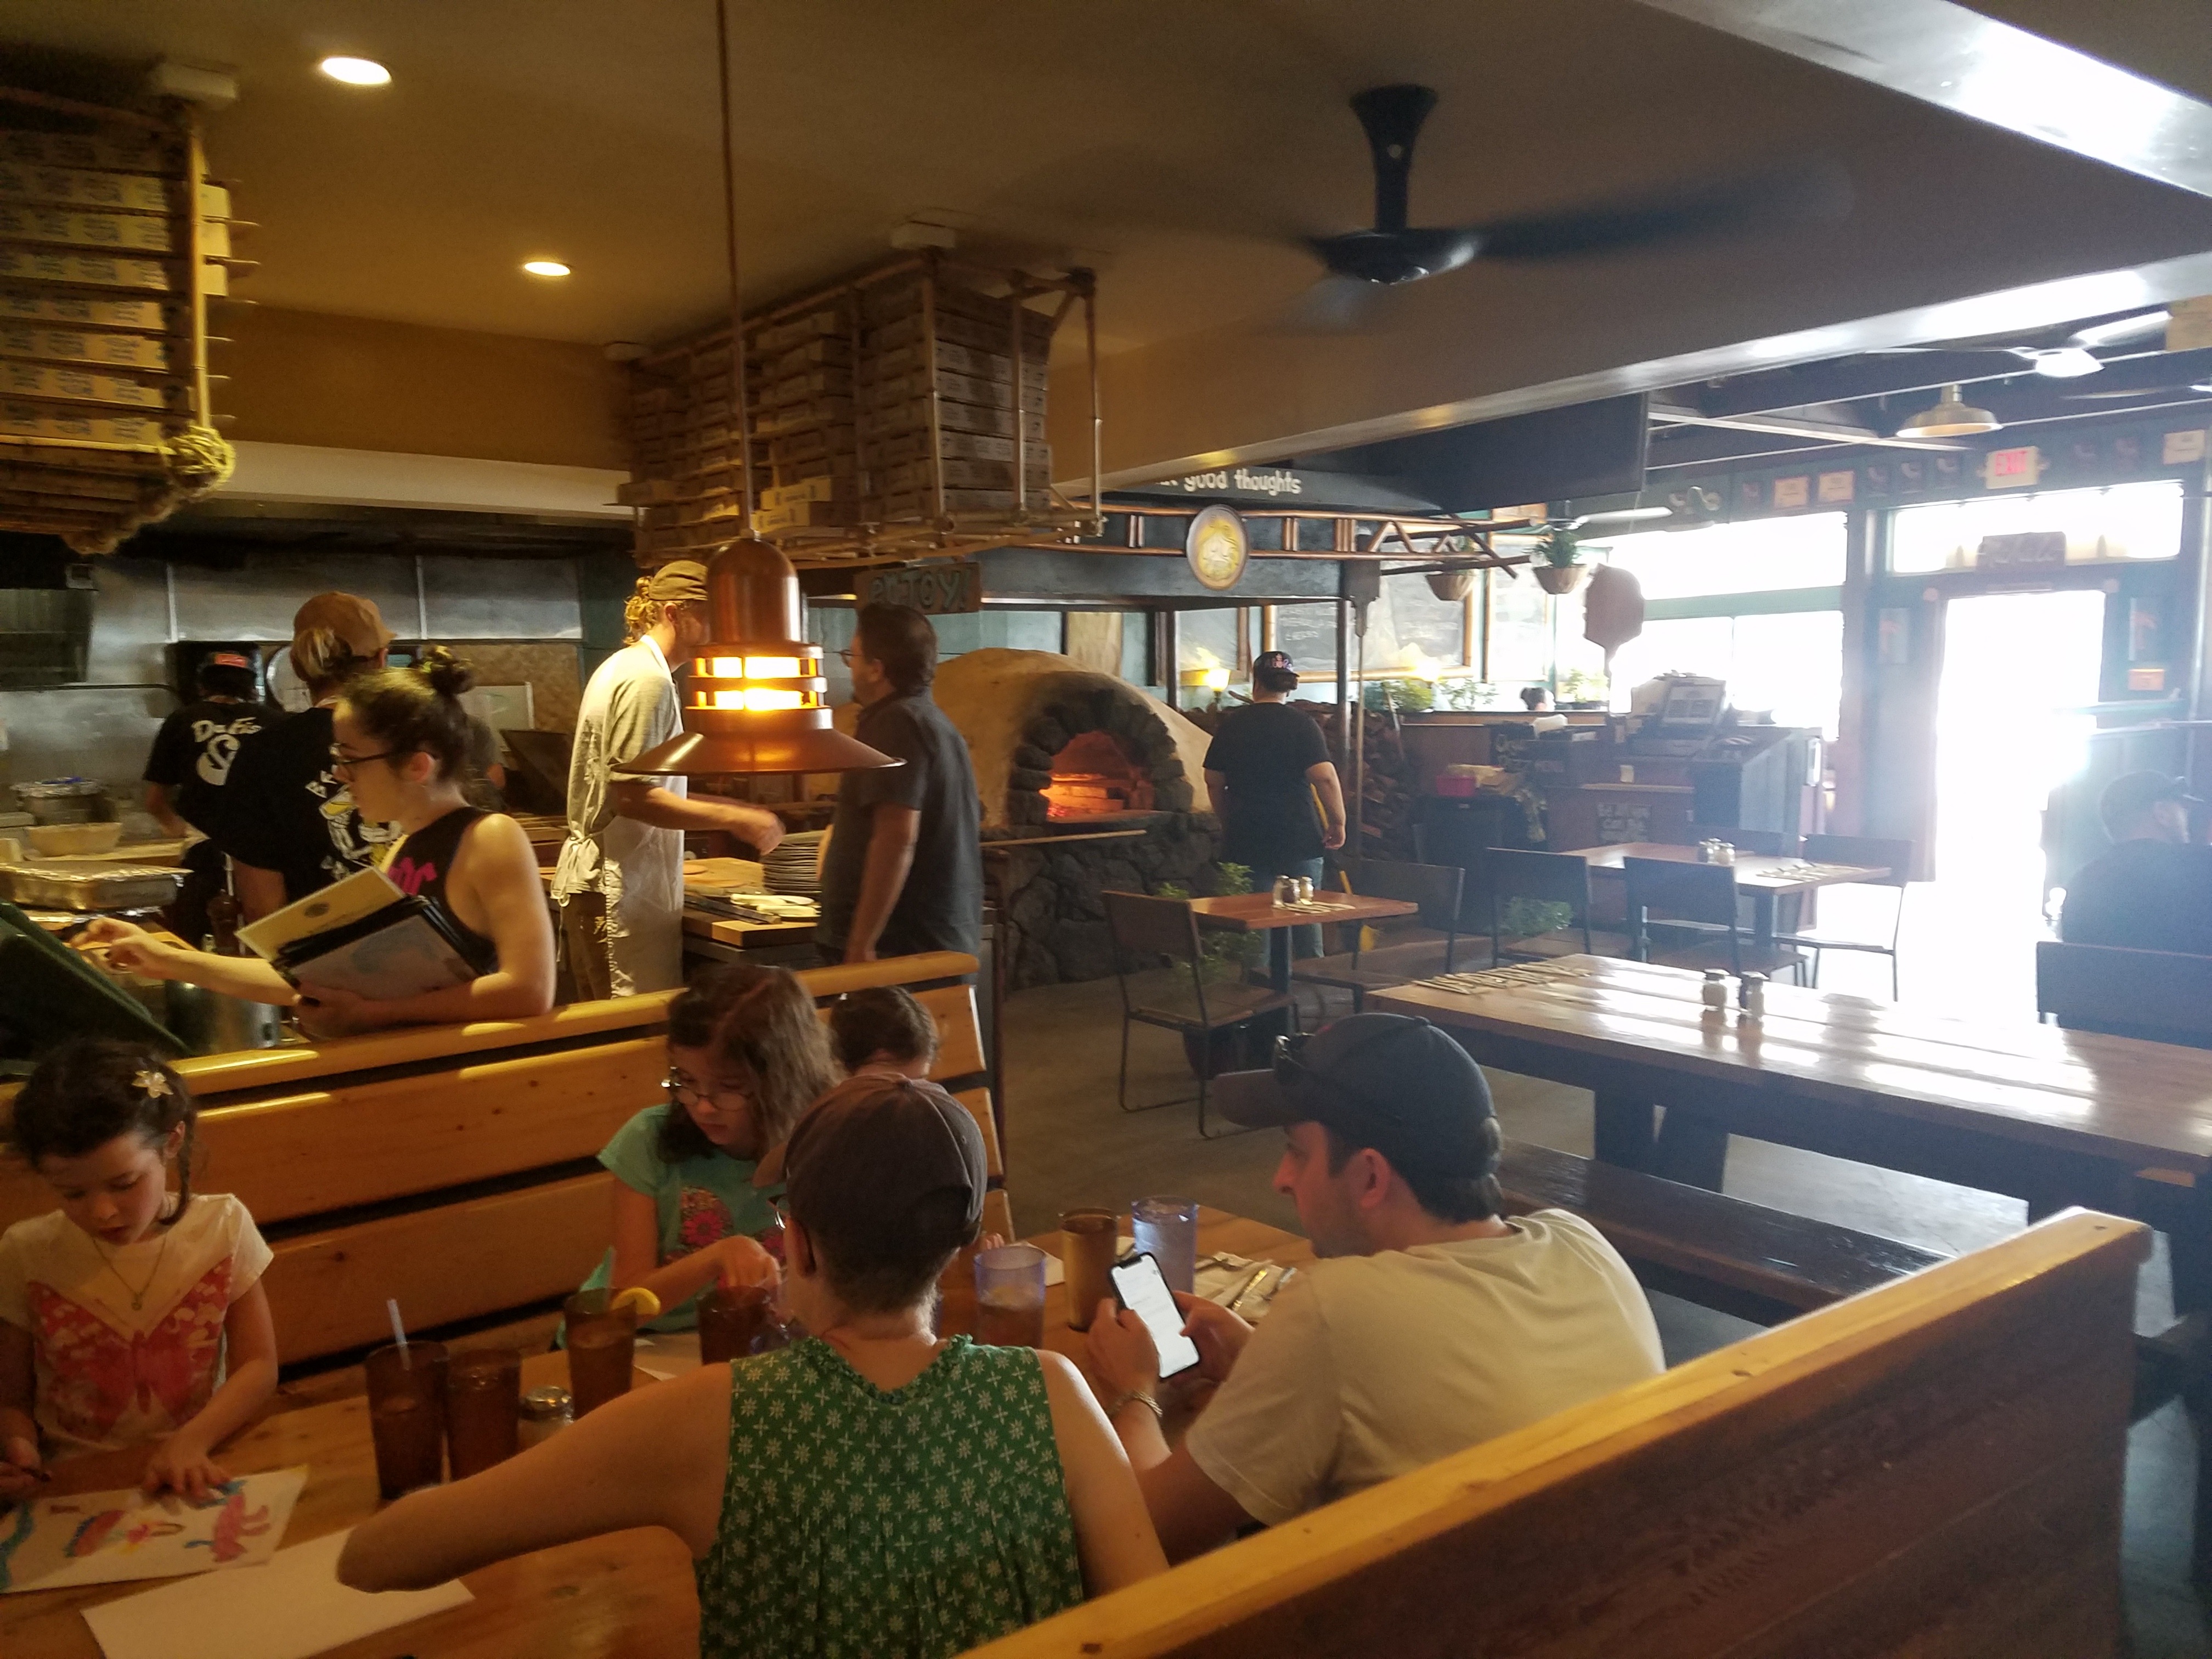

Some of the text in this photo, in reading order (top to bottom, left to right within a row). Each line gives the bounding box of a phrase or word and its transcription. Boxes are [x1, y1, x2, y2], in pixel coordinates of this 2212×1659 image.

[1994, 450, 2029, 476] EXIT
[1184, 468, 1302, 496] good thoughts
